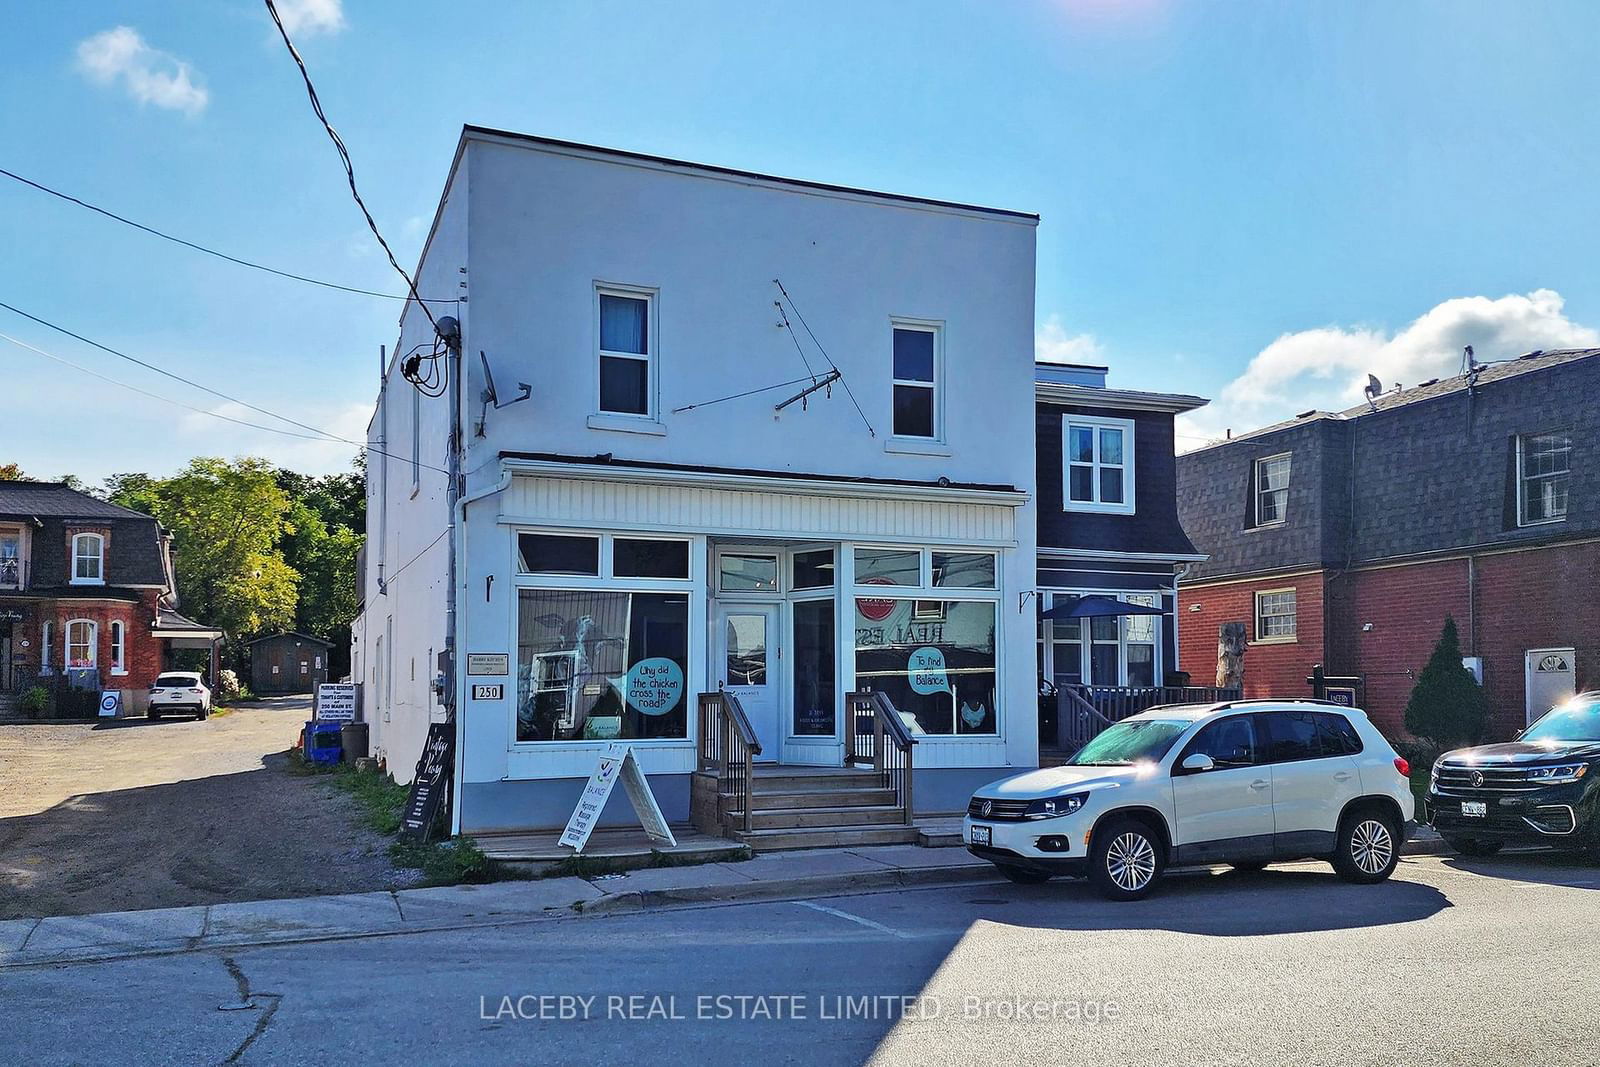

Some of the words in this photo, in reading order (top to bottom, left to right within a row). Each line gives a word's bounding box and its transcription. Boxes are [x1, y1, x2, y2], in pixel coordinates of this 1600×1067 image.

[916, 656, 925, 665] To
[928, 656, 941, 666] find
[640, 666, 655, 678] Why
[658, 665, 669, 674] did
[633, 678, 646, 688] the
[650, 678, 678, 688] chicken
[916, 674, 944, 686] Balance
[480, 687, 497, 698] 250
[657, 689, 670, 699] the
[639, 699, 666, 708] road?
